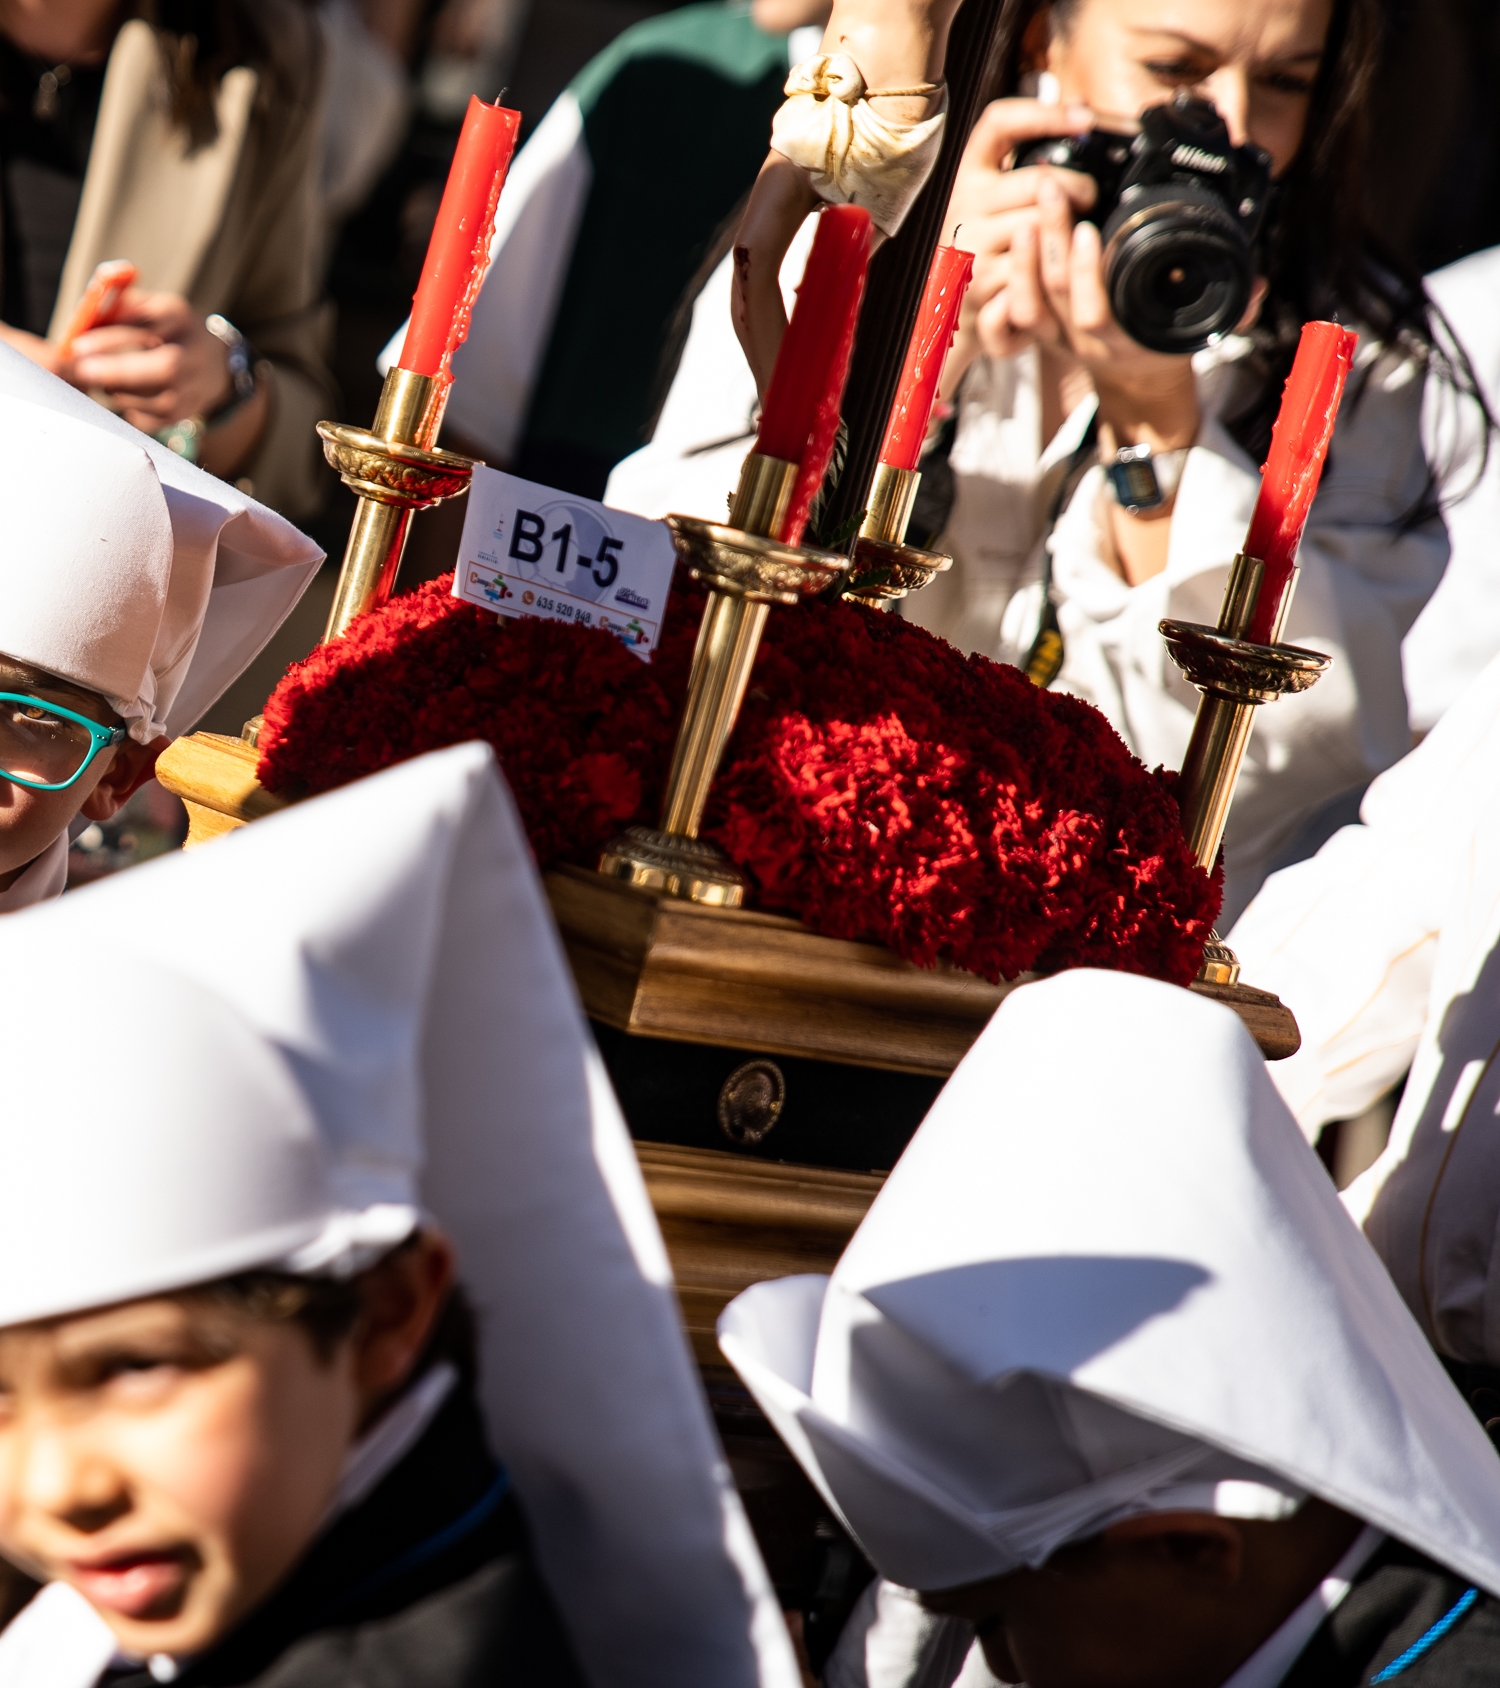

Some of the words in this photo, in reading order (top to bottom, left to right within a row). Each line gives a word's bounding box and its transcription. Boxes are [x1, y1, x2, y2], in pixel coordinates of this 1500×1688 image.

[1171, 143, 1228, 174] Nikon
[508, 508, 624, 588] B1-5
[536, 595, 554, 611] 635
[555, 602, 573, 618] 520
[574, 608, 592, 624] 848
